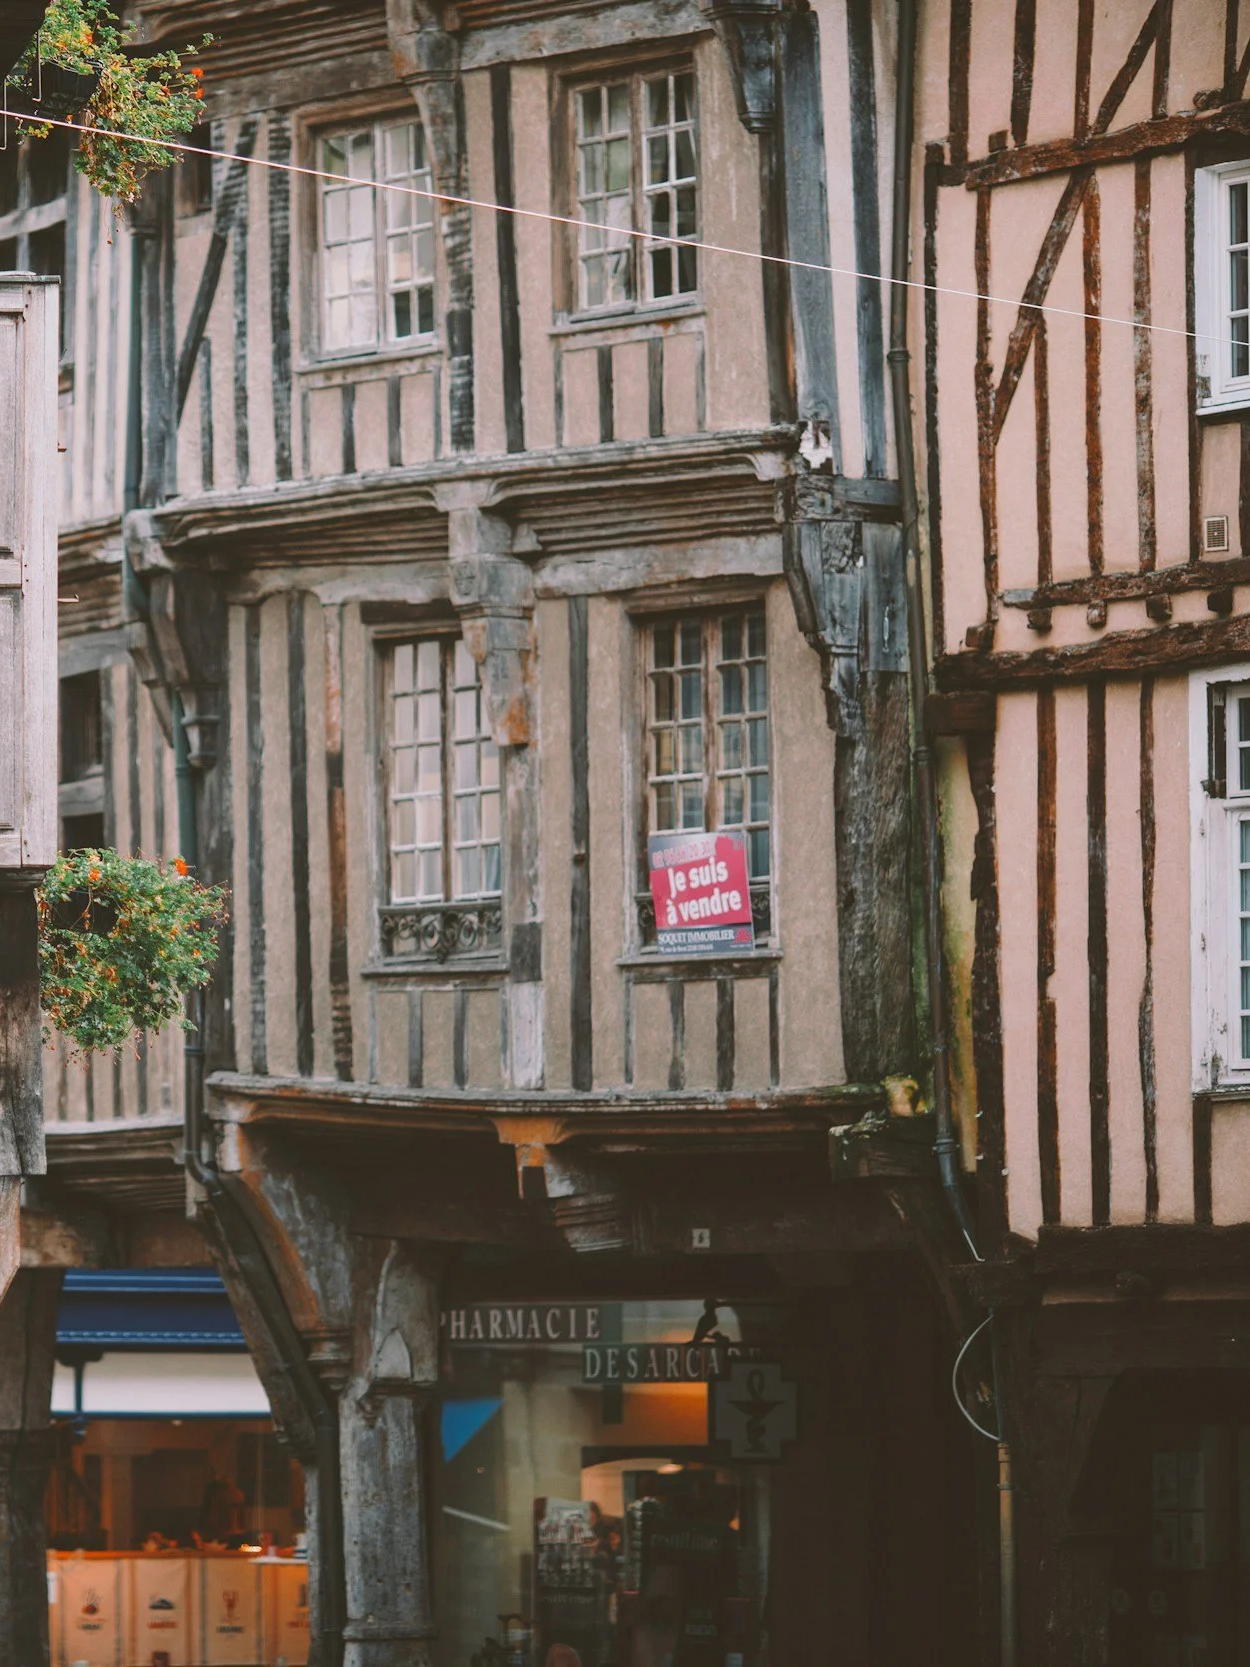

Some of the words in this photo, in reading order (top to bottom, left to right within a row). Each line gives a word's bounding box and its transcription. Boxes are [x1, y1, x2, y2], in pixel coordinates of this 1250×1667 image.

[688, 856, 729, 889] suis
[666, 899, 678, 926] à
[678, 887, 742, 922] vendre
[687, 929, 735, 943] IMMOBILIER
